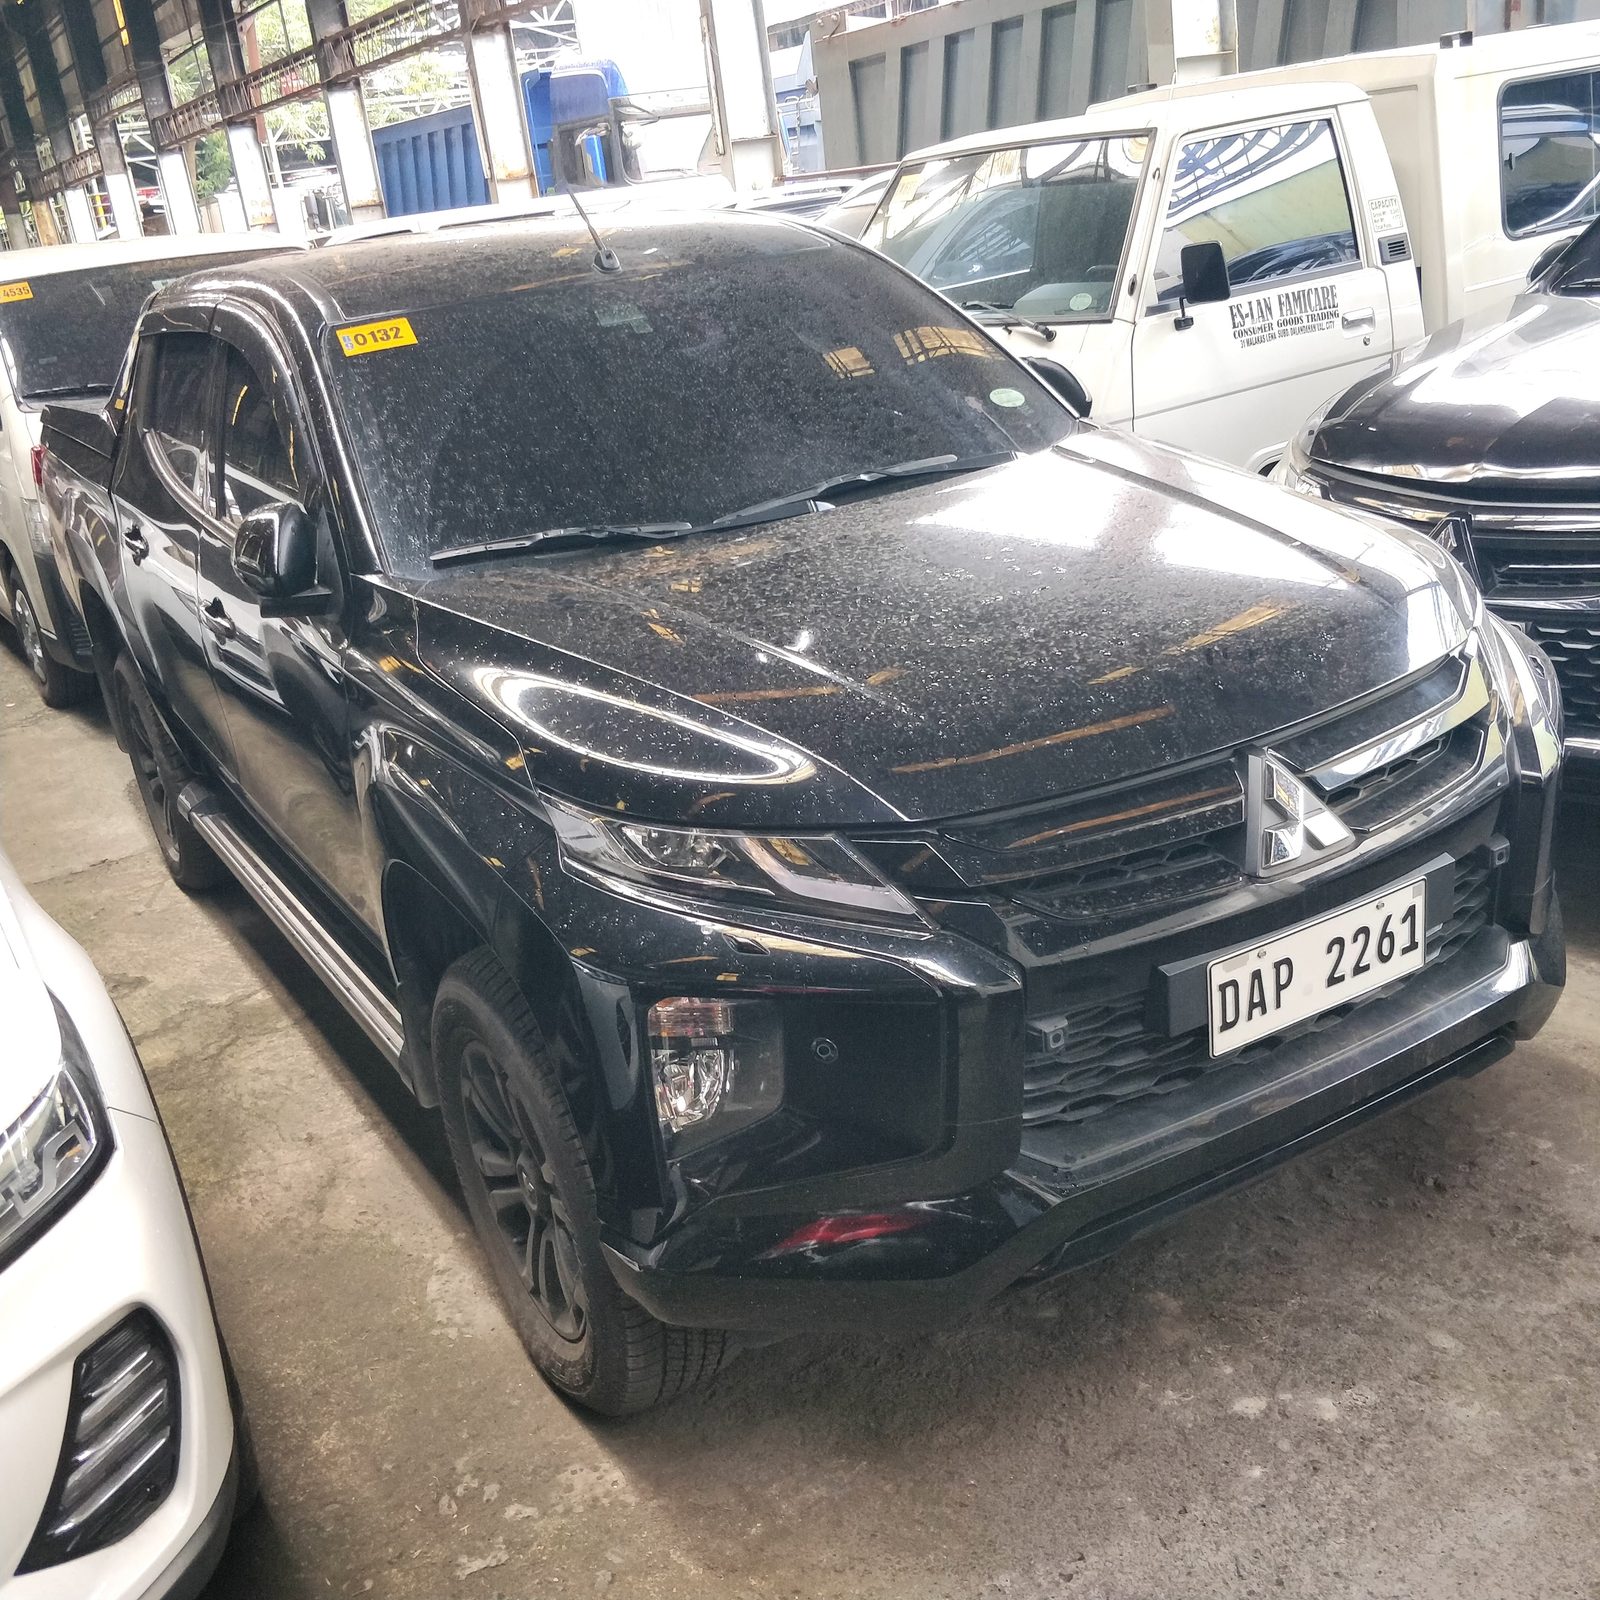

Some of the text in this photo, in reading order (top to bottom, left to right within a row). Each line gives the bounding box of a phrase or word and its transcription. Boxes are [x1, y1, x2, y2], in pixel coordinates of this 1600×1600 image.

[1371, 198, 1397, 210] CAPACITY
[3, 287, 30, 298] 4535
[1228, 284, 1339, 329] ES-LAN FAMICARE
[353, 326, 404, 347] 0132
[1233, 309, 1340, 340] CONSUMER GOODS TRADING
[1219, 904, 1419, 1033] DAP 2261
